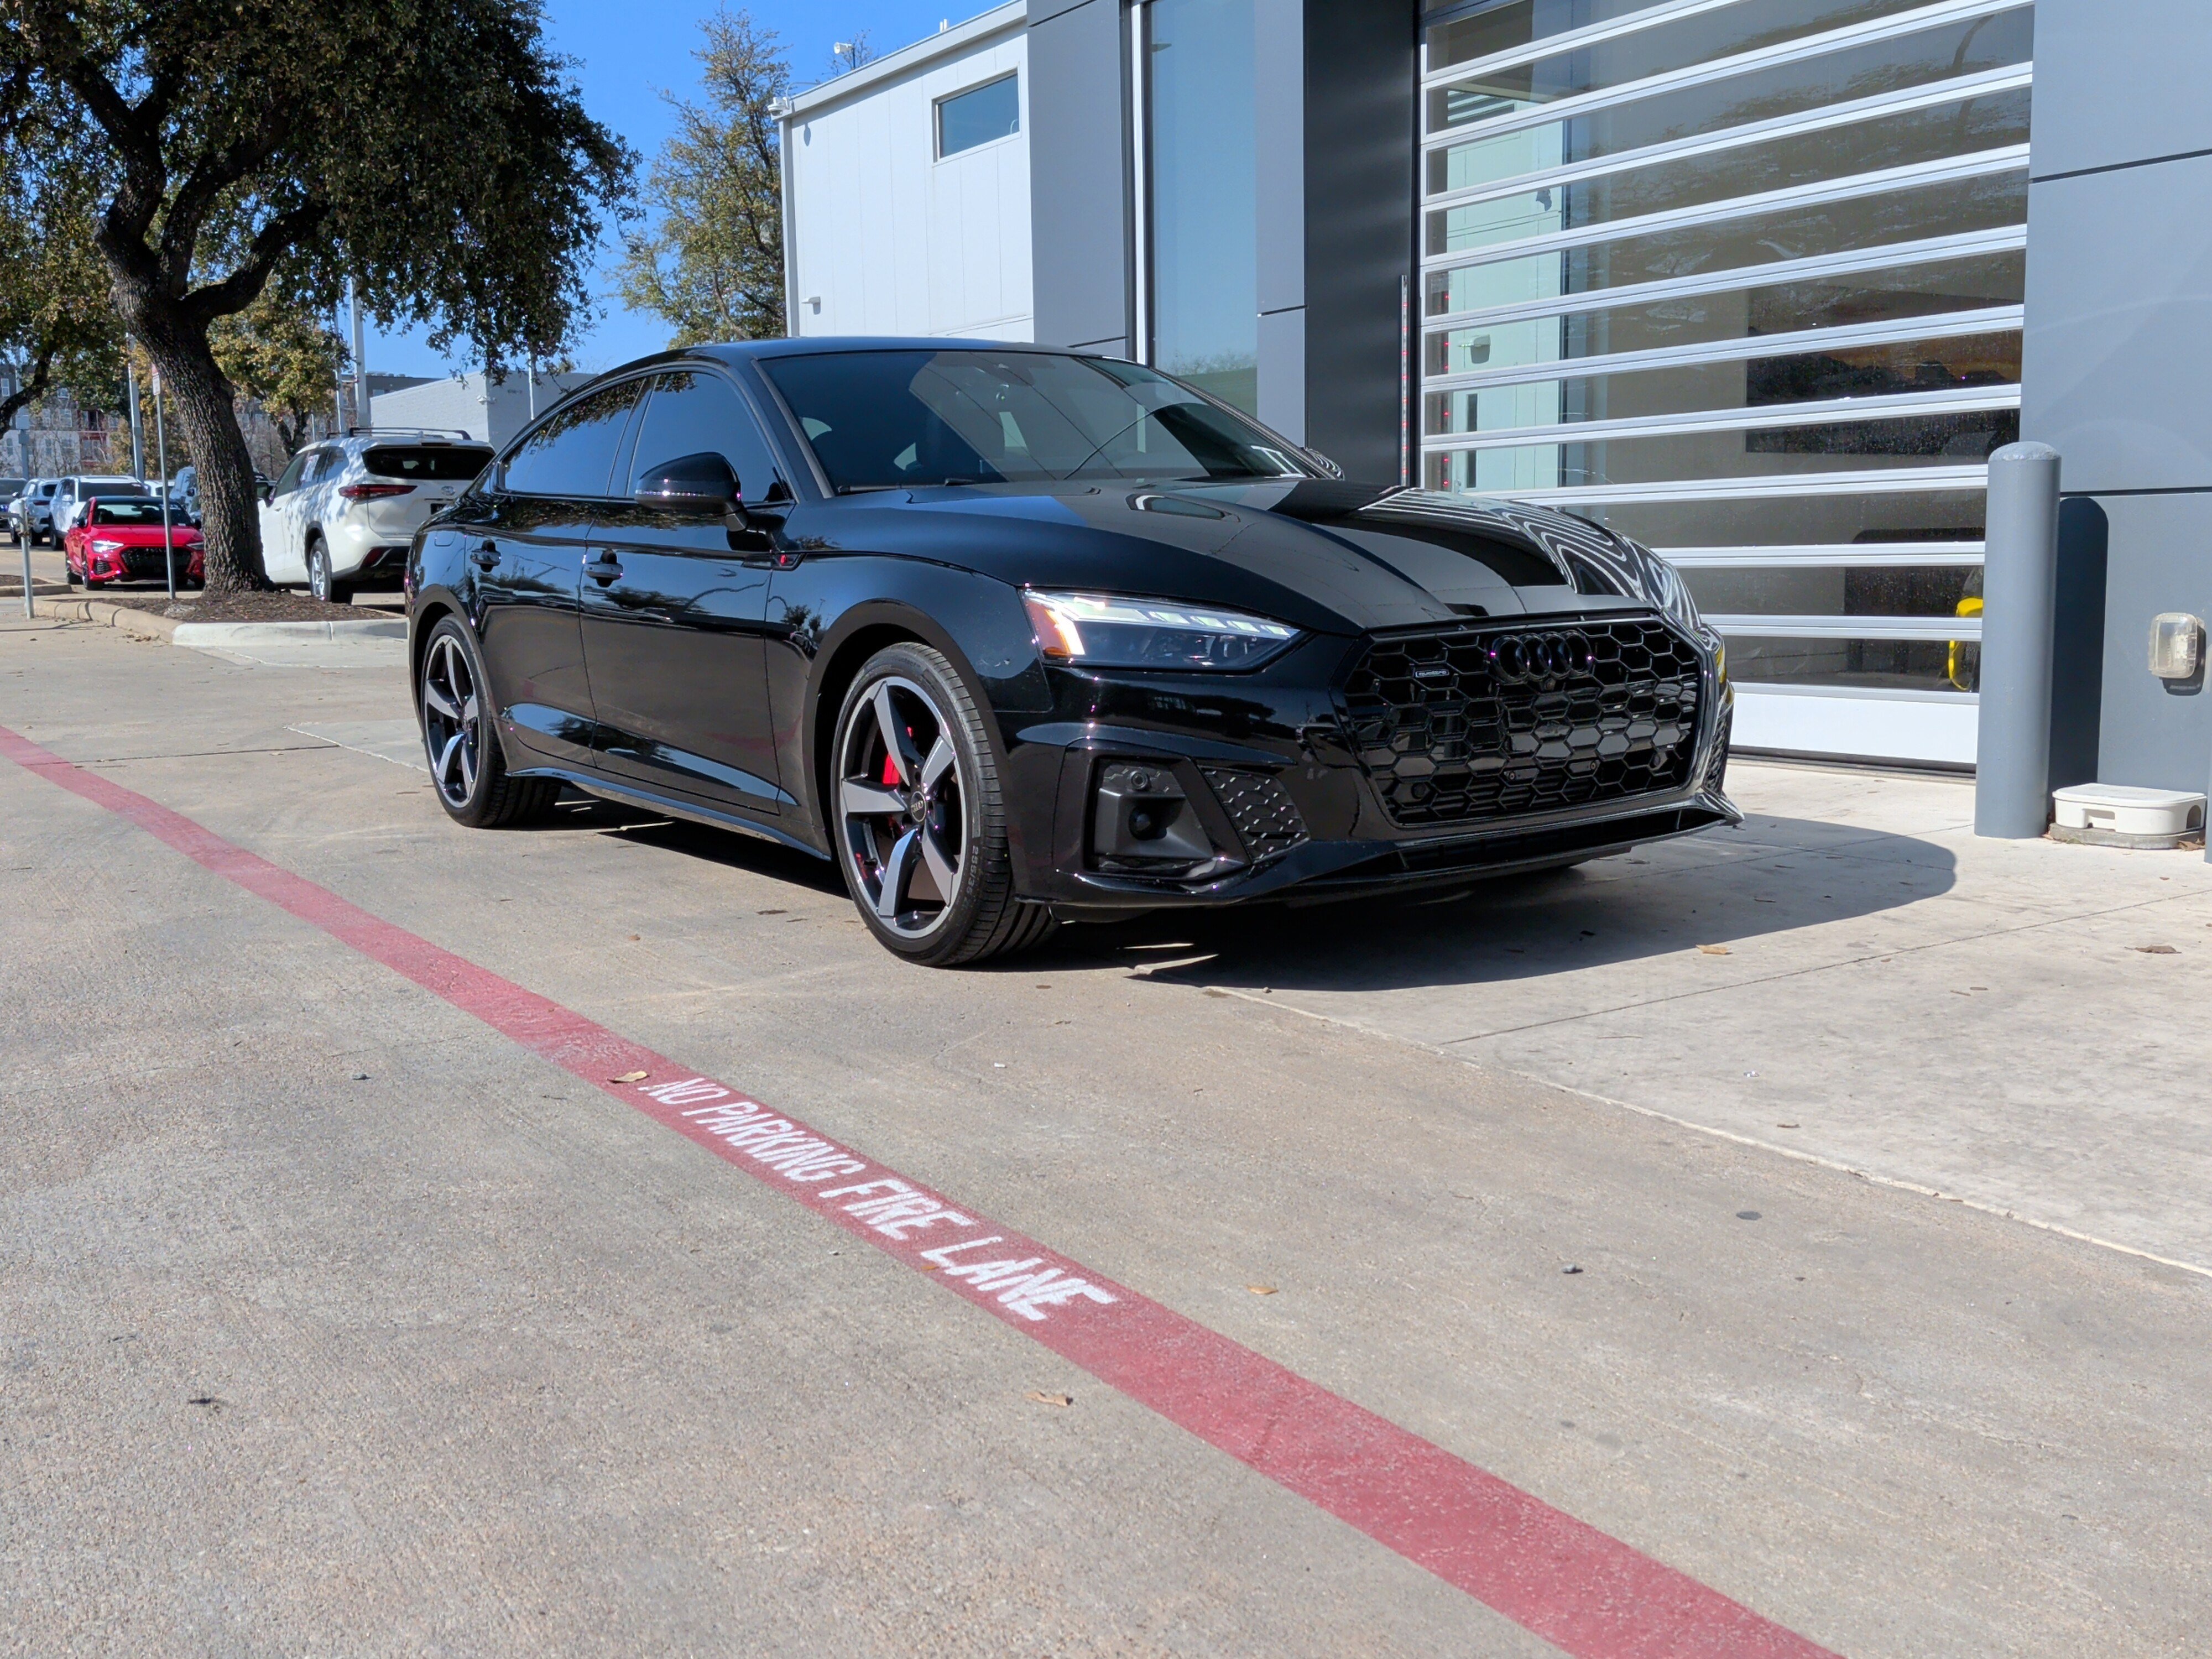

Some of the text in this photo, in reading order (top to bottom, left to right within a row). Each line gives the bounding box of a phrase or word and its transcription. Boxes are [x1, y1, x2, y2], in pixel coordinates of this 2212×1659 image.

[637, 1077, 1119, 1321] NO PARKING FIRE LANE
